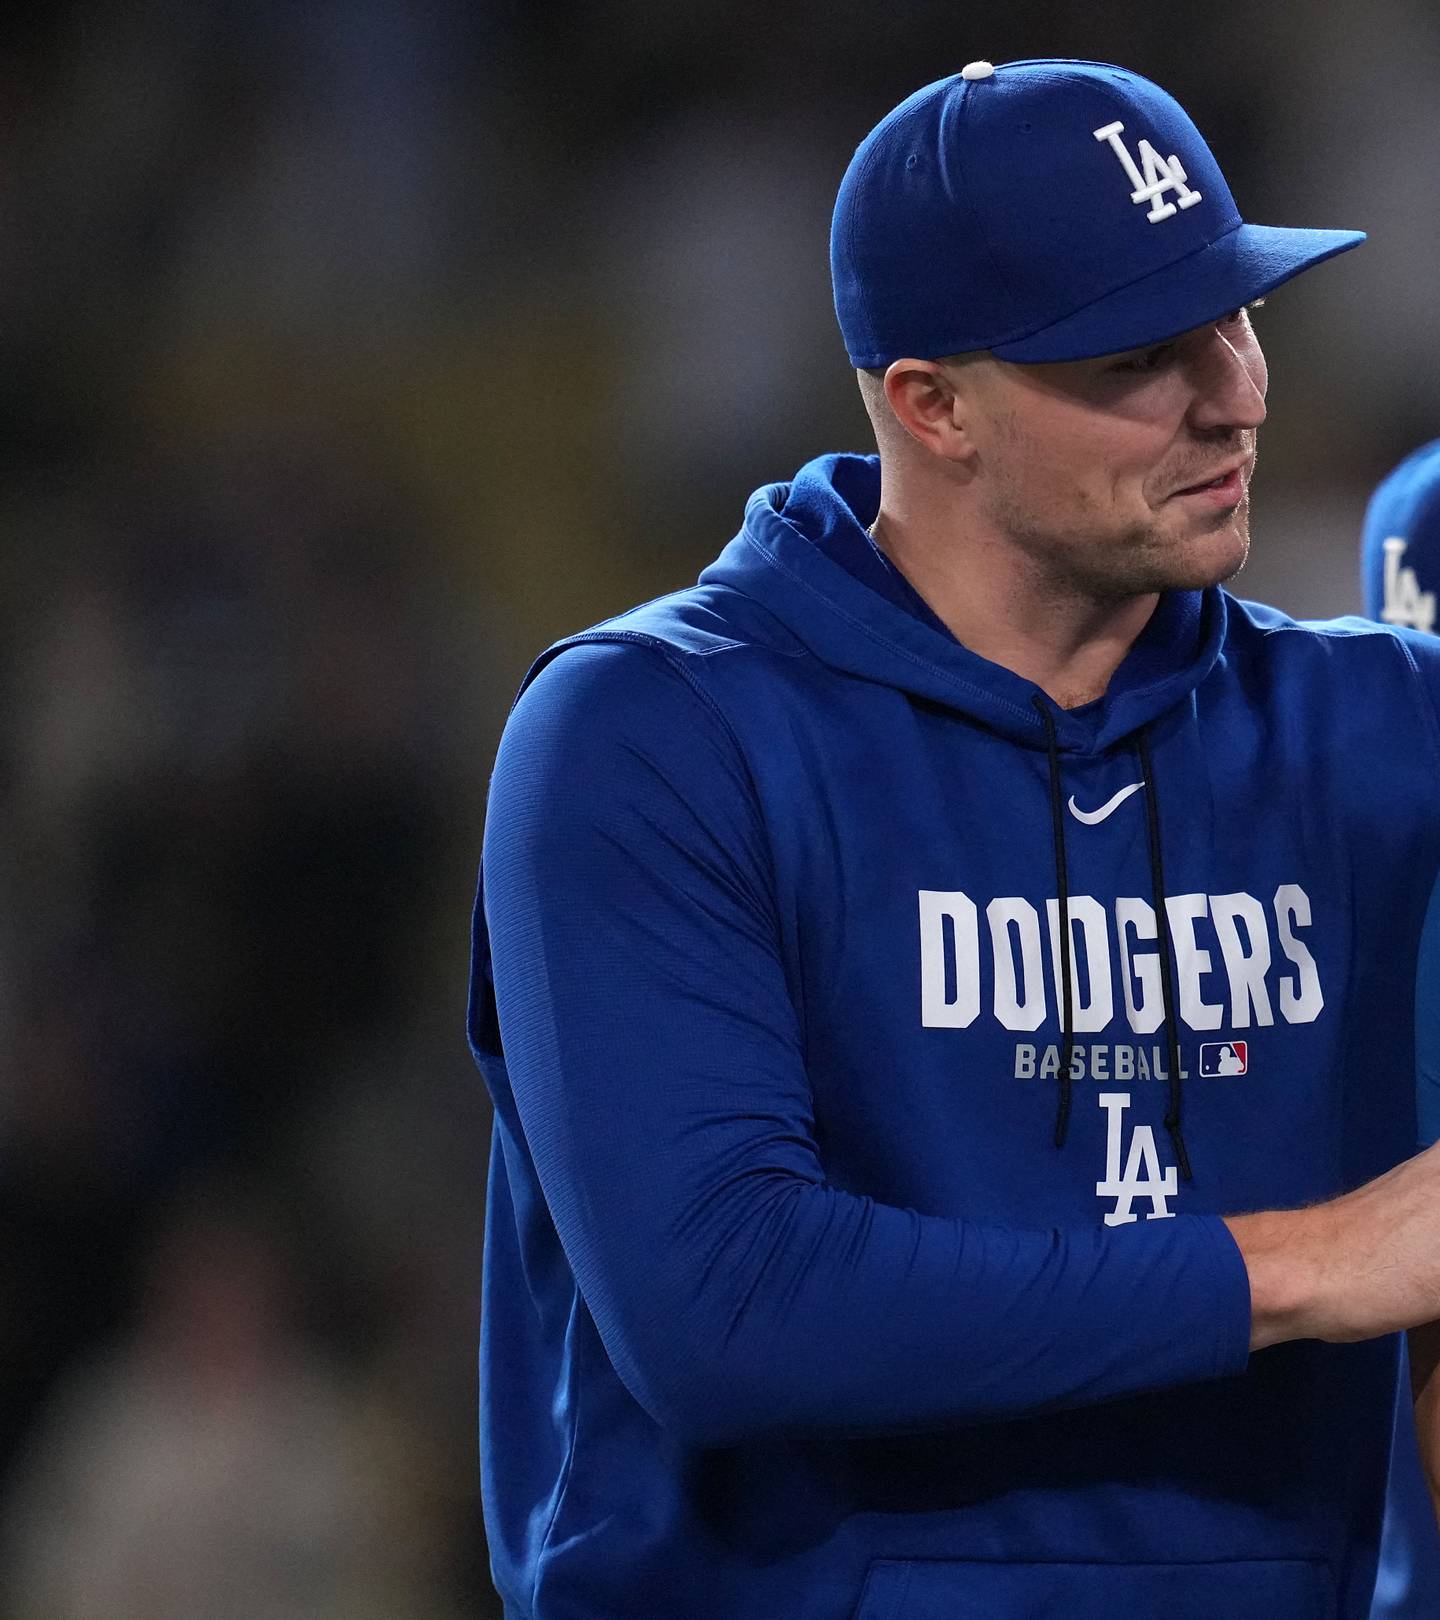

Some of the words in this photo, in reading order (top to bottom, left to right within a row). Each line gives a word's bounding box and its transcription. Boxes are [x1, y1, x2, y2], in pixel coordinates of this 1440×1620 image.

[1093, 120, 1202, 224] LA
[1381, 537, 1437, 632] LA
[918, 884, 1324, 1034] DODGERS
[1014, 1043, 1189, 1081] BASEBALL
[1096, 1092, 1178, 1227] LA
